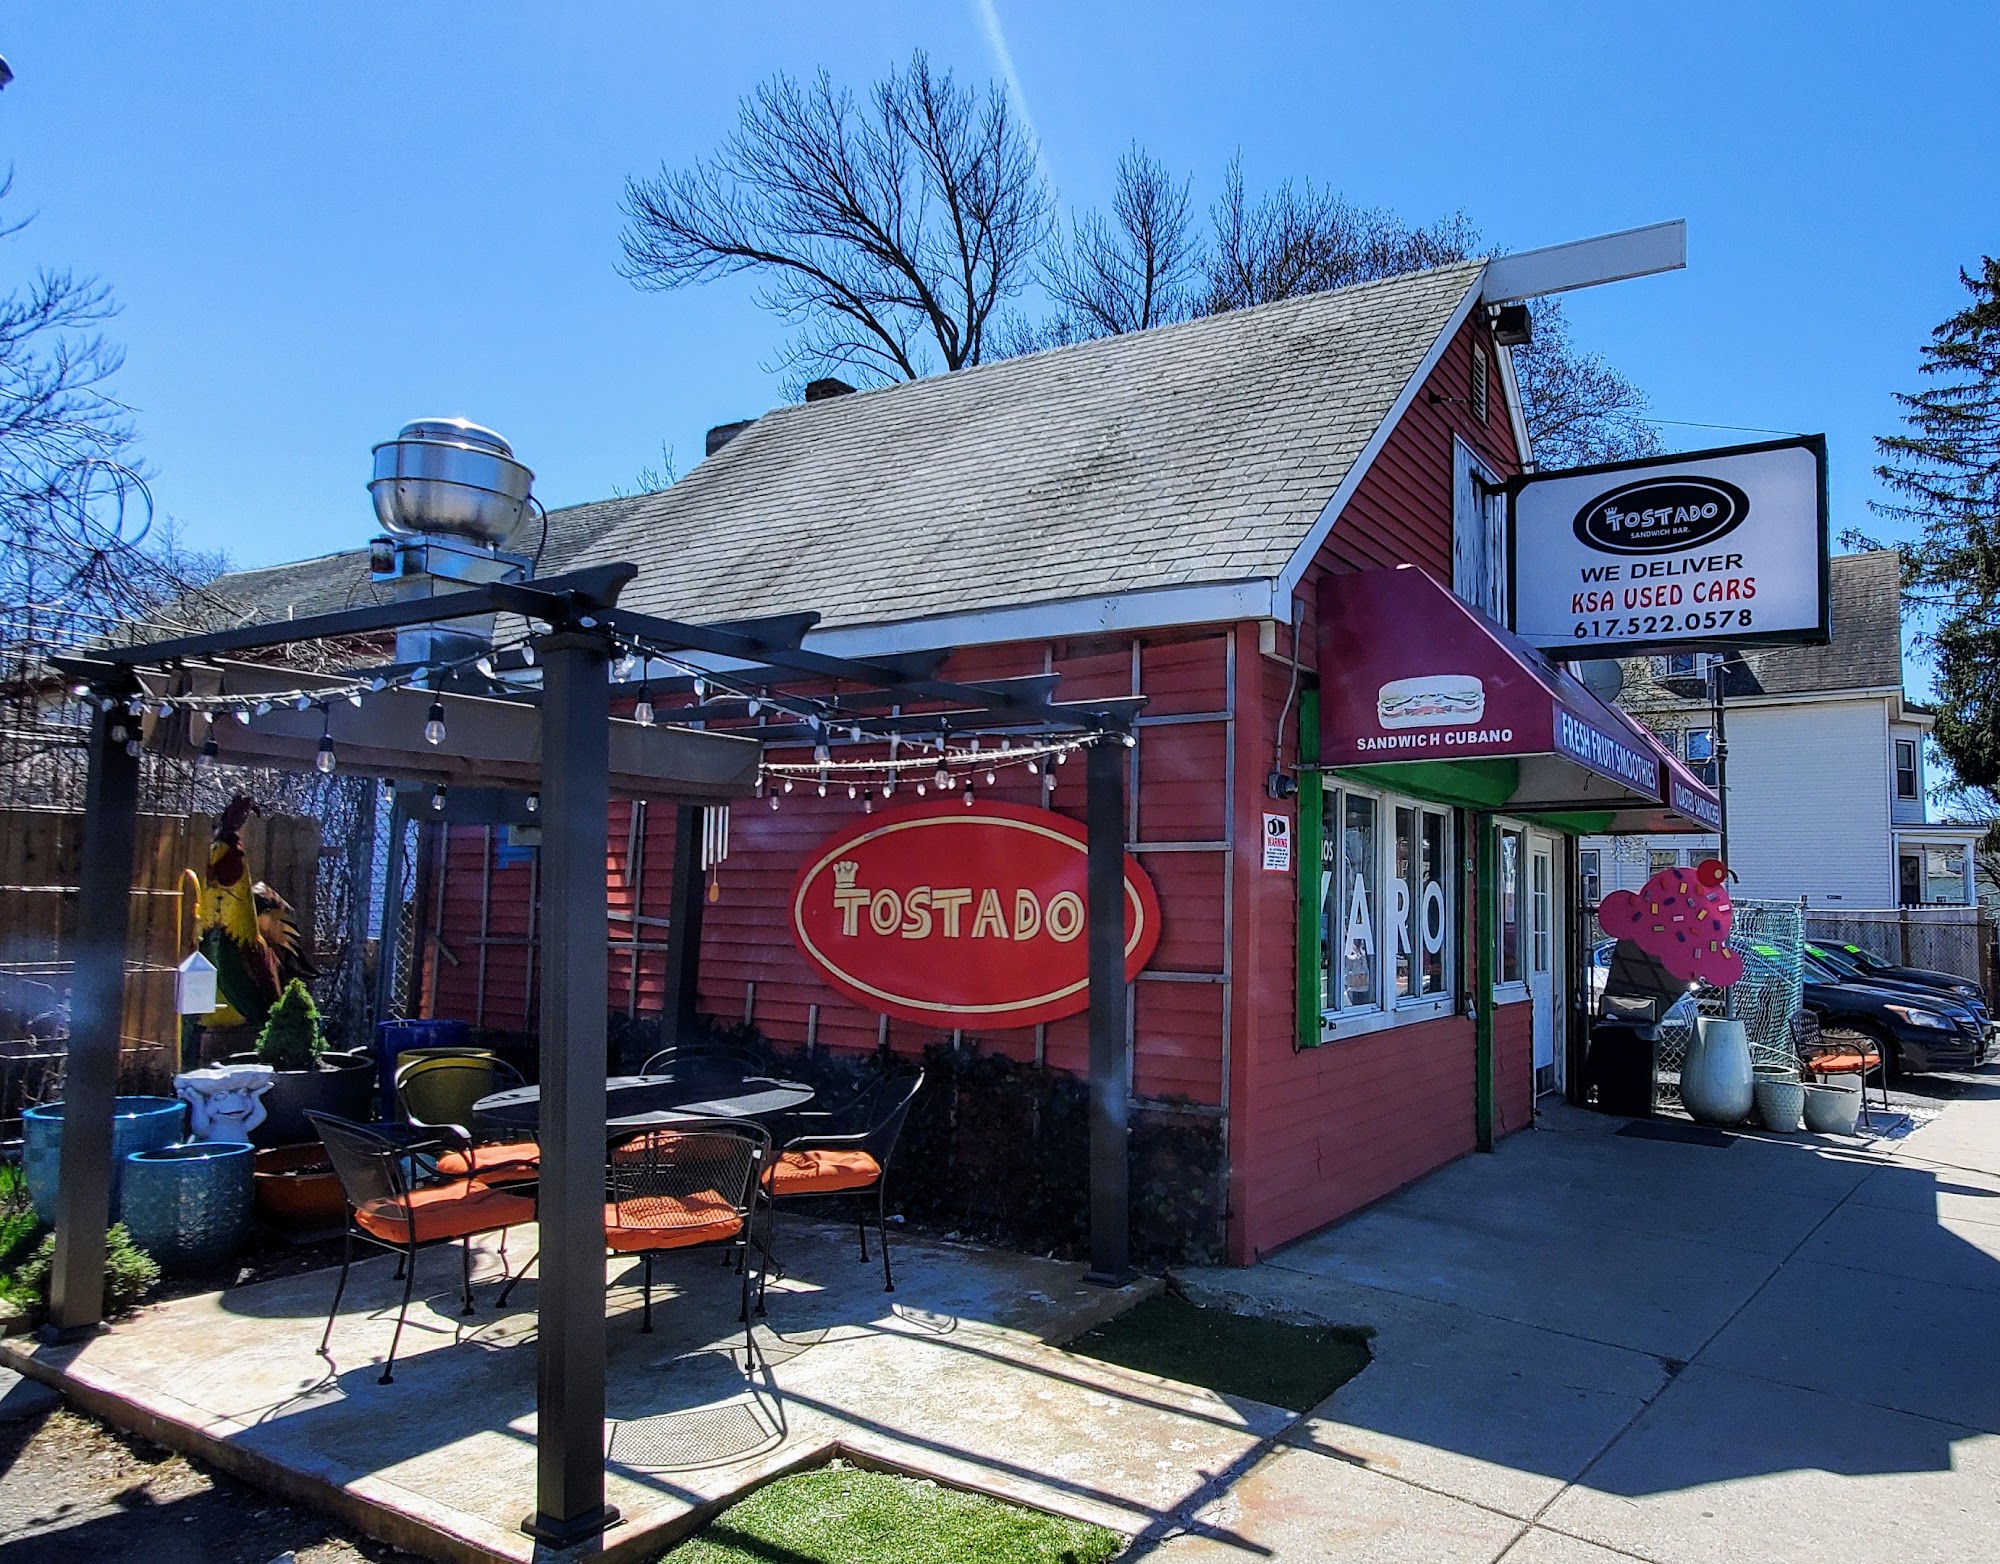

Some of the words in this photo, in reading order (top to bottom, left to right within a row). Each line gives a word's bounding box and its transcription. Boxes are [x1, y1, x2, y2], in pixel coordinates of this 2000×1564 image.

[1606, 502, 1718, 532] TOSTADO
[1630, 528, 1671, 539] SANDWICH
[1580, 565, 1621, 583] WE
[1630, 553, 1744, 580] DELIVER
[1571, 590, 1615, 614] KSA
[1623, 584, 1684, 610] USED
[1693, 577, 1757, 604] CARS
[1574, 608, 1753, 639] 617.522.0578
[1356, 732, 1440, 751] SANDWICH
[1444, 728, 1514, 745] CUBANO
[1562, 711, 1592, 759] FRESH
[1591, 729, 1615, 771] FRUIT
[1615, 743, 1656, 790] SMOOTHIES
[833, 885, 1086, 943] TOSTADO
